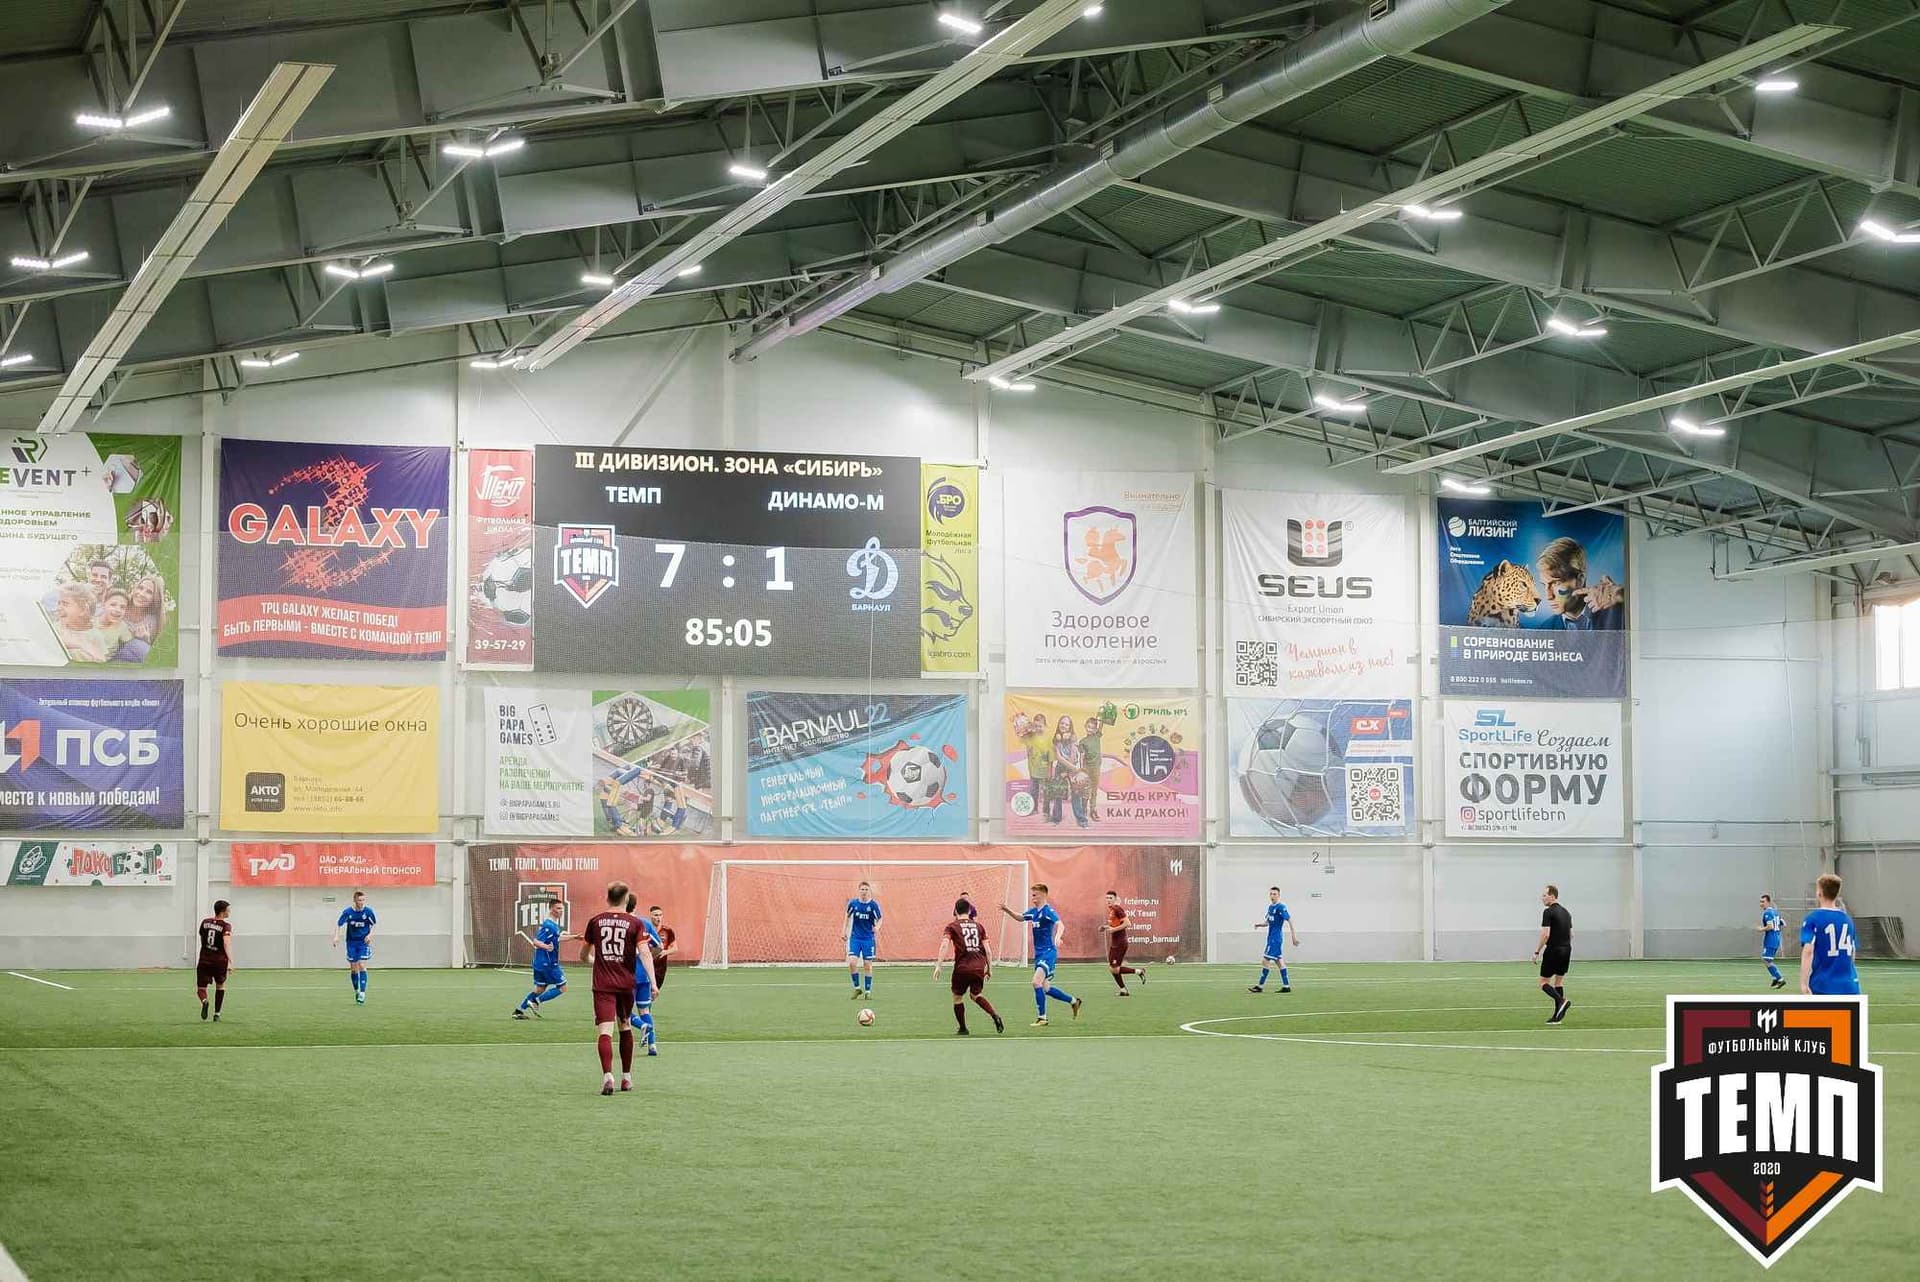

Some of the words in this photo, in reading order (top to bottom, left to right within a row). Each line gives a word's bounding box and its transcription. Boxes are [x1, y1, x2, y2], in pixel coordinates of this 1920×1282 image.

[599, 452, 720, 473] ДИВИЗИОН.
[724, 457, 779, 475] ЗОНА
[783, 460, 883, 477] «СИБИРЬ»
[605, 486, 661, 504] ТЕМП
[767, 491, 884, 511] ДИНАМО-М
[30, 510, 91, 518] УПРАВЛЕНИЕ
[228, 503, 440, 548] GALAXY
[1467, 519, 1518, 527] БАЛТИЙСКИЙ
[1467, 526, 1518, 538] ЛИЗИНГ
[560, 547, 612, 577] ТЕМП
[655, 544, 686, 588] 7
[766, 546, 794, 591] 1
[1257, 574, 1373, 599] SEUS
[261, 602, 280, 615] ТРЦ
[282, 604, 319, 617] GALAXY
[321, 607, 360, 623] ЖЕЛАЕТ
[851, 603, 891, 612] БАРНАУЛ
[1287, 604, 1316, 616] Export
[1051, 610, 1150, 630] Здоровое
[1258, 615, 1301, 624] СИБИРСКИЙ
[223, 621, 251, 637] БЫТЬ
[253, 619, 301, 633] ПЕРВЫМИ
[310, 623, 348, 640] ВМЕСТЕ
[350, 627, 357, 640] С
[359, 628, 412, 646] КОМАНДОЙ
[685, 618, 772, 647] 85:05
[475, 640, 527, 651] 39-57-29
[1044, 634, 1158, 649] поколение
[1463, 636, 1554, 649] СОРЕВНОВАНИЕ
[1463, 650, 1471, 659] В
[1474, 650, 1529, 662] ПРИРОДЕ
[1532, 651, 1583, 661] БИЗНЕСА
[499, 704, 516, 717] BIG
[1143, 708, 1171, 716] ГРИЛЬ
[1474, 709, 1516, 727] SL
[234, 712, 292, 730] Очень
[297, 717, 380, 735] хорошие
[384, 719, 428, 732] окна
[499, 719, 525, 731] PAPA
[499, 732, 533, 745] GAMES
[1458, 729, 1533, 744] SportLife
[56, 729, 160, 766] ПСБ
[1459, 752, 1608, 770] СПОРТИВНУЮ
[760, 766, 824, 788] ГЕНЕРАЛЬНЫЙ
[250, 785, 280, 796] АКТО
[760, 777, 847, 807] ИНФОРМАЦИОННЫЙ
[1106, 791, 1145, 801] БУДЬ
[1459, 772, 1608, 805] ФОРМУ
[38, 792, 46, 805] к
[50, 791, 95, 806] новым
[99, 787, 160, 807] победам!
[760, 806, 800, 823] ПАРТНЕР
[1106, 809, 1131, 817] КАК
[1135, 808, 1189, 819] ДРАКОН!
[1478, 807, 1566, 823] sportlifebrn
[319, 856, 337, 864] ОАО
[489, 858, 512, 872] ТЕМП,
[515, 858, 539, 872] ТЕМП,
[541, 858, 573, 871] ТОЛЬКО
[575, 858, 599, 871] ТЕМП!
[1312, 852, 1319, 863] 2
[319, 864, 379, 874] ГЕНЕРАЛЬНЫЙ
[381, 866, 421, 875] СПОНСОР
[208, 930, 216, 946] 8
[600, 927, 626, 956] 25
[962, 928, 980, 947] 23
[1127, 935, 1180, 944] ctemp_barnaul
[1824, 923, 1853, 957] 14
